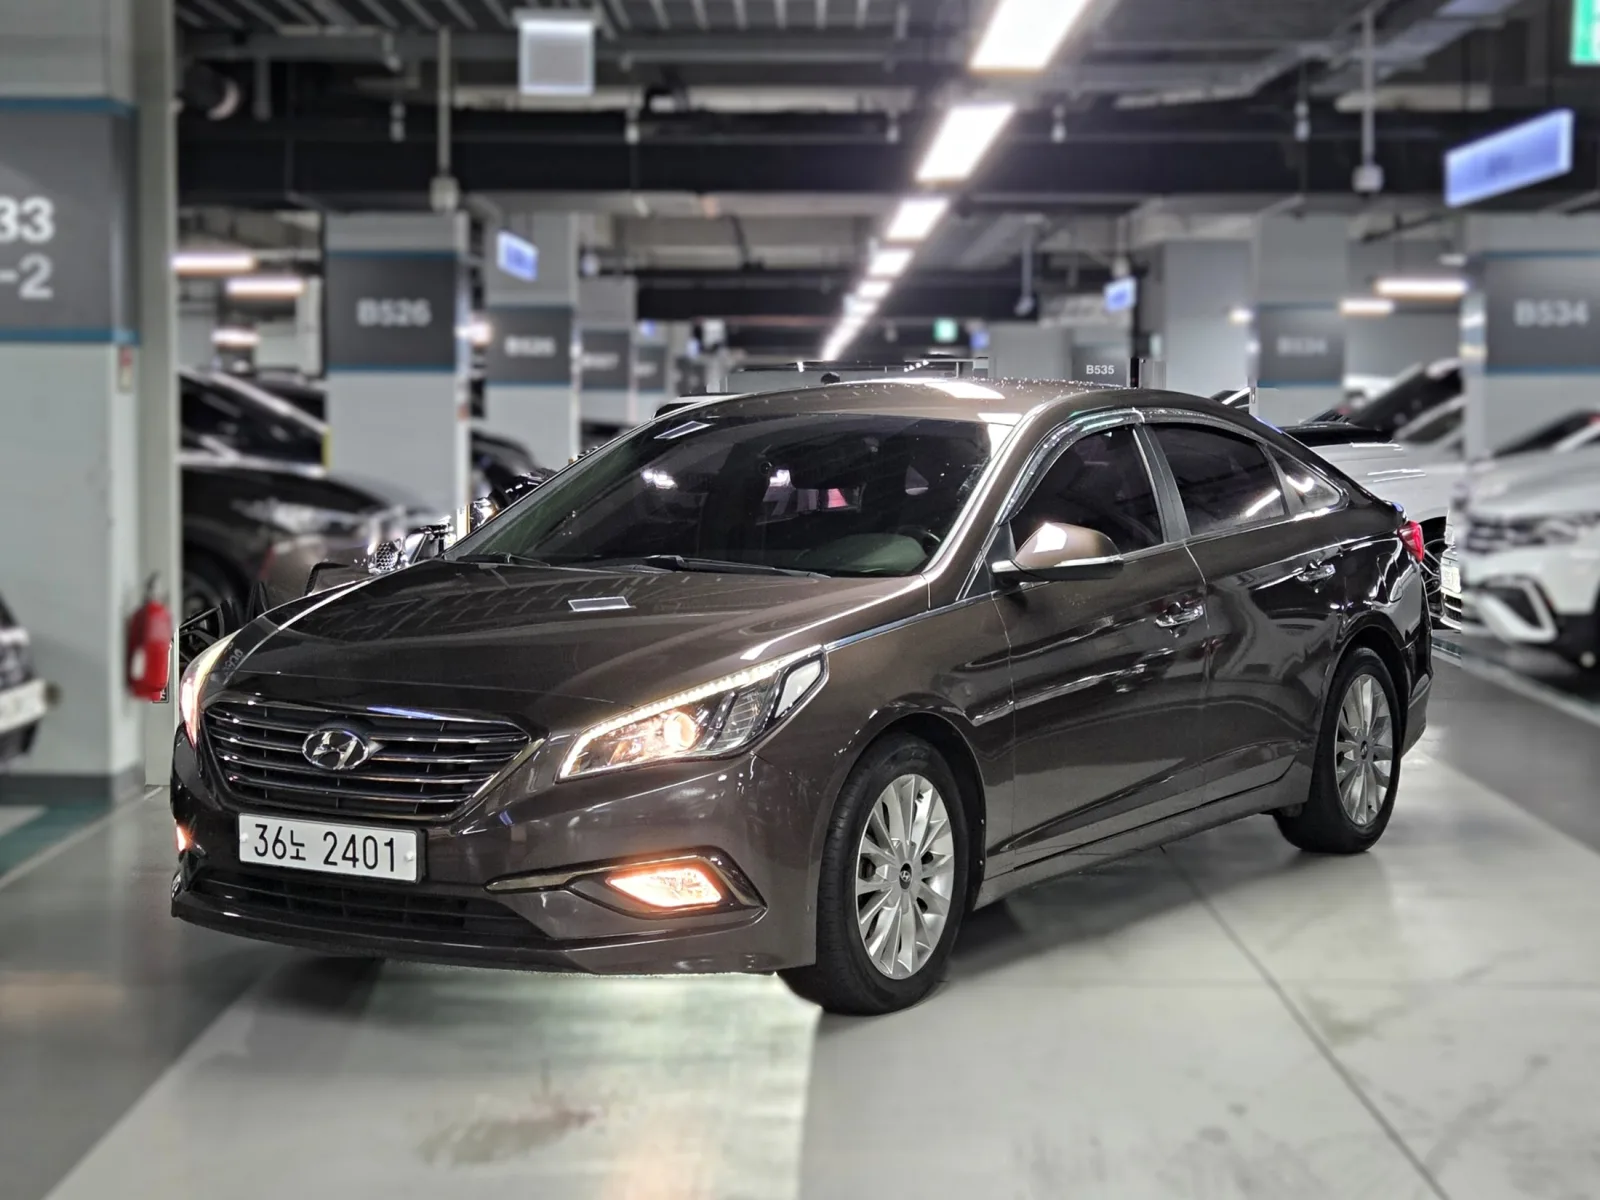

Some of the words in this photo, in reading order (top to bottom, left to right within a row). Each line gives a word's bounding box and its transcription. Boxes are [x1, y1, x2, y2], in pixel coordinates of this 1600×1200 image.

[357, 298, 431, 327] B526
[1515, 299, 1589, 328] B534
[1086, 364, 1115, 375] B535
[254, 823, 307, 861] 36노
[322, 831, 395, 872] 2401
